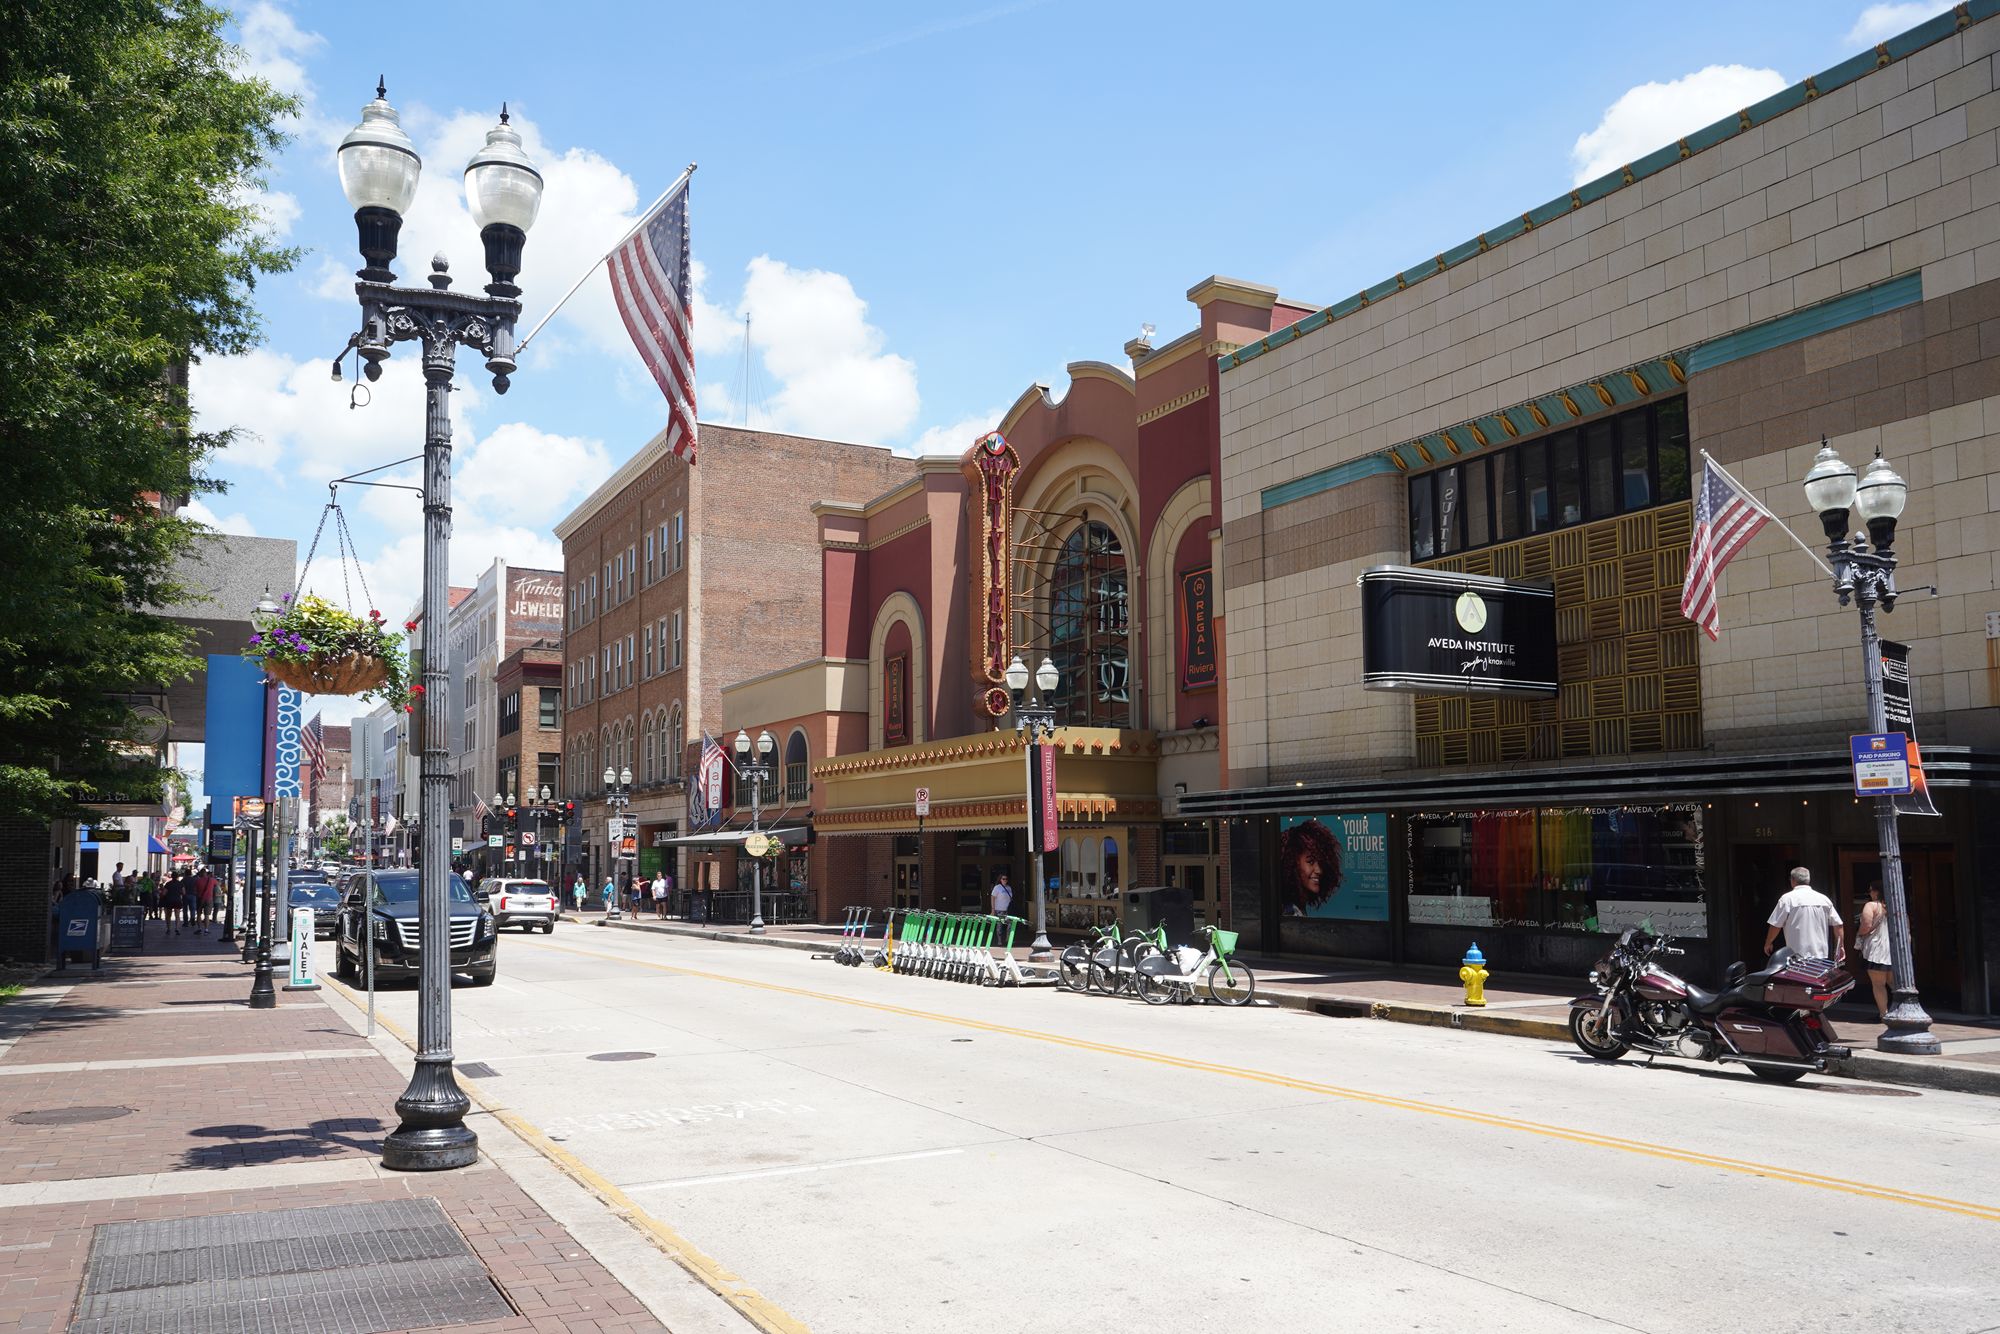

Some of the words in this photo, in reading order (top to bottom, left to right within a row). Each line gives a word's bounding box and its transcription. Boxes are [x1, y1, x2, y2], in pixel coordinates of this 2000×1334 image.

[988, 475, 1006, 672] RIVIERA
[1196, 601, 1205, 655] REGAL
[1428, 637, 1463, 650] AVEDA
[1465, 640, 1515, 654] INSTITUTE
[1188, 664, 1214, 675] Riviera
[1488, 657, 1516, 666] knoxville
[991, 691, 1003, 712] 8
[1045, 752, 1053, 786] THEATRE
[1627, 806, 1653, 814] AVEDA
[1674, 804, 1702, 812] AVEDA
[1343, 820, 1369, 834] YOUR
[1347, 836, 1385, 851] FUTURE
[300, 932, 308, 978] VALET
